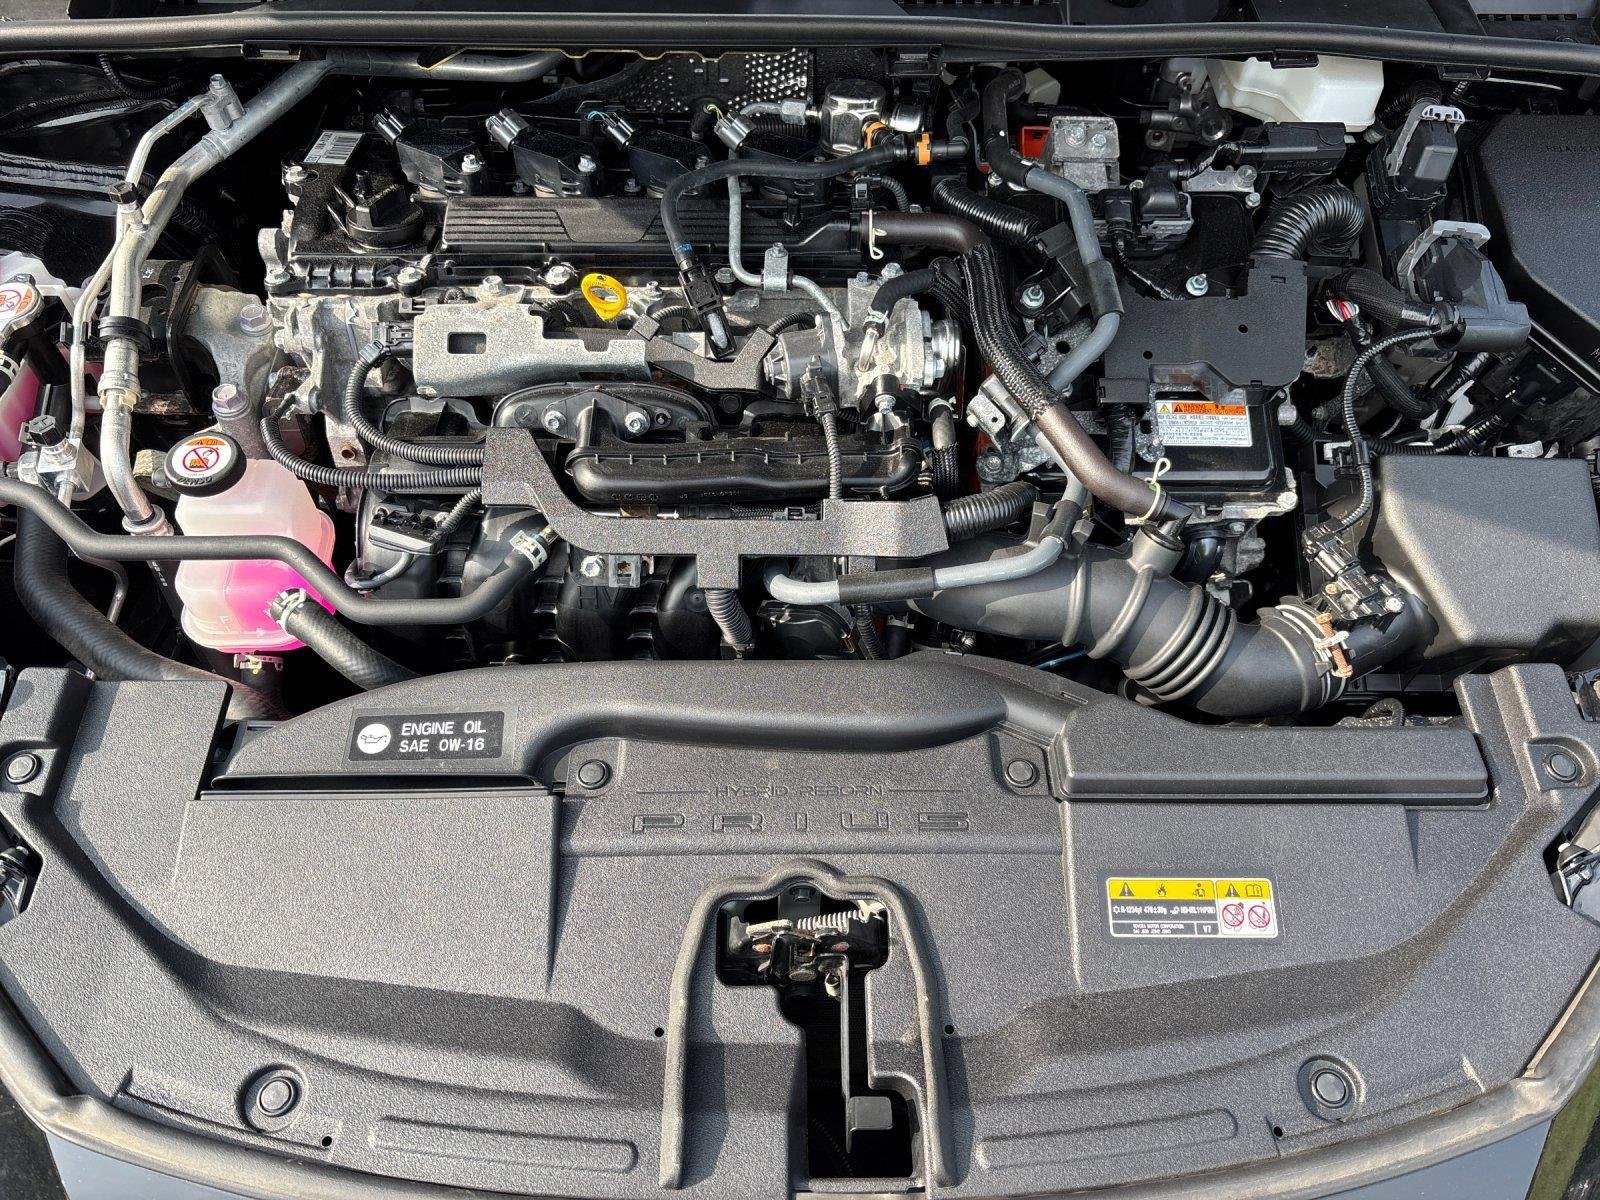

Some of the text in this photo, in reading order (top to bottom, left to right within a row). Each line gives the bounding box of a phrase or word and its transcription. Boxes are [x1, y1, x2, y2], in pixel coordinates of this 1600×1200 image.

[177, 476, 213, 486] DENSO
[401, 720, 486, 736] ENGINE OIL
[399, 738, 485, 753] SAE 0W-16
[715, 785, 884, 798] HYBRID REBORN
[632, 811, 970, 834] PRIUS
